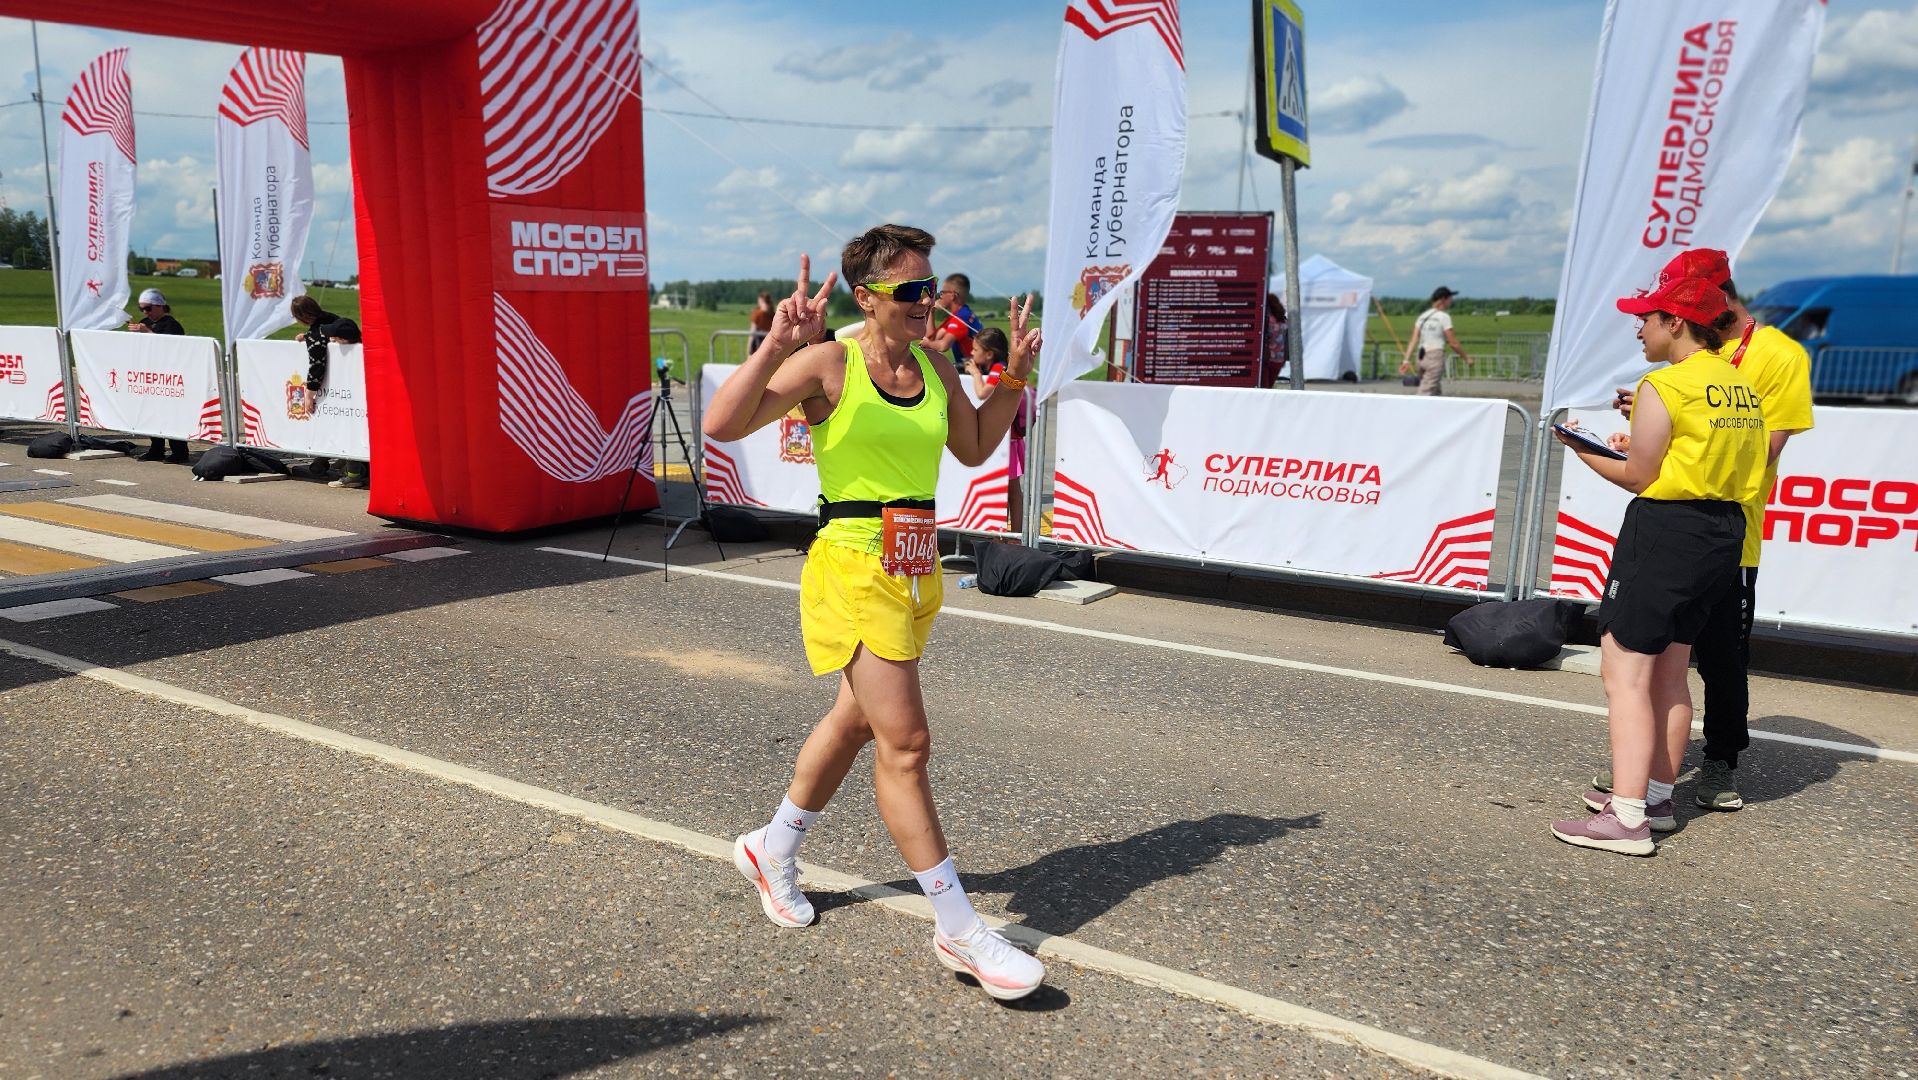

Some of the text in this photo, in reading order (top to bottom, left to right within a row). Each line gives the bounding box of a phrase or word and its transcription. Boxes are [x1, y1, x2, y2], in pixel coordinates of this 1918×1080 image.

[1642, 22, 1713, 248] СУПЕРЛИГА
[1672, 20, 1738, 246] ПОДМОСКОВЬЯ
[1106, 105, 1134, 257] Губернатора
[88, 160, 98, 261] СУПЕРЛИГА
[266, 165, 280, 258] Губернатора
[1086, 156, 1107, 258] Команда
[252, 197, 263, 259] Команда
[511, 221, 643, 251] МОСОБЛ
[513, 249, 620, 277] СПОРТ
[127, 370, 185, 387] СУПЕРЛИГА
[127, 385, 185, 398] ПОДМОСКОВЬЯ
[316, 388, 352, 400] оманда
[317, 403, 368, 418] убернато
[1706, 384, 1759, 412] СУДЬ
[1204, 453, 1381, 485] СУПЕРЛИГА
[1203, 477, 1381, 505] ПОДМОСКОВЬЯ
[1767, 475, 1918, 514] ОСО
[894, 531, 935, 561] 5048
